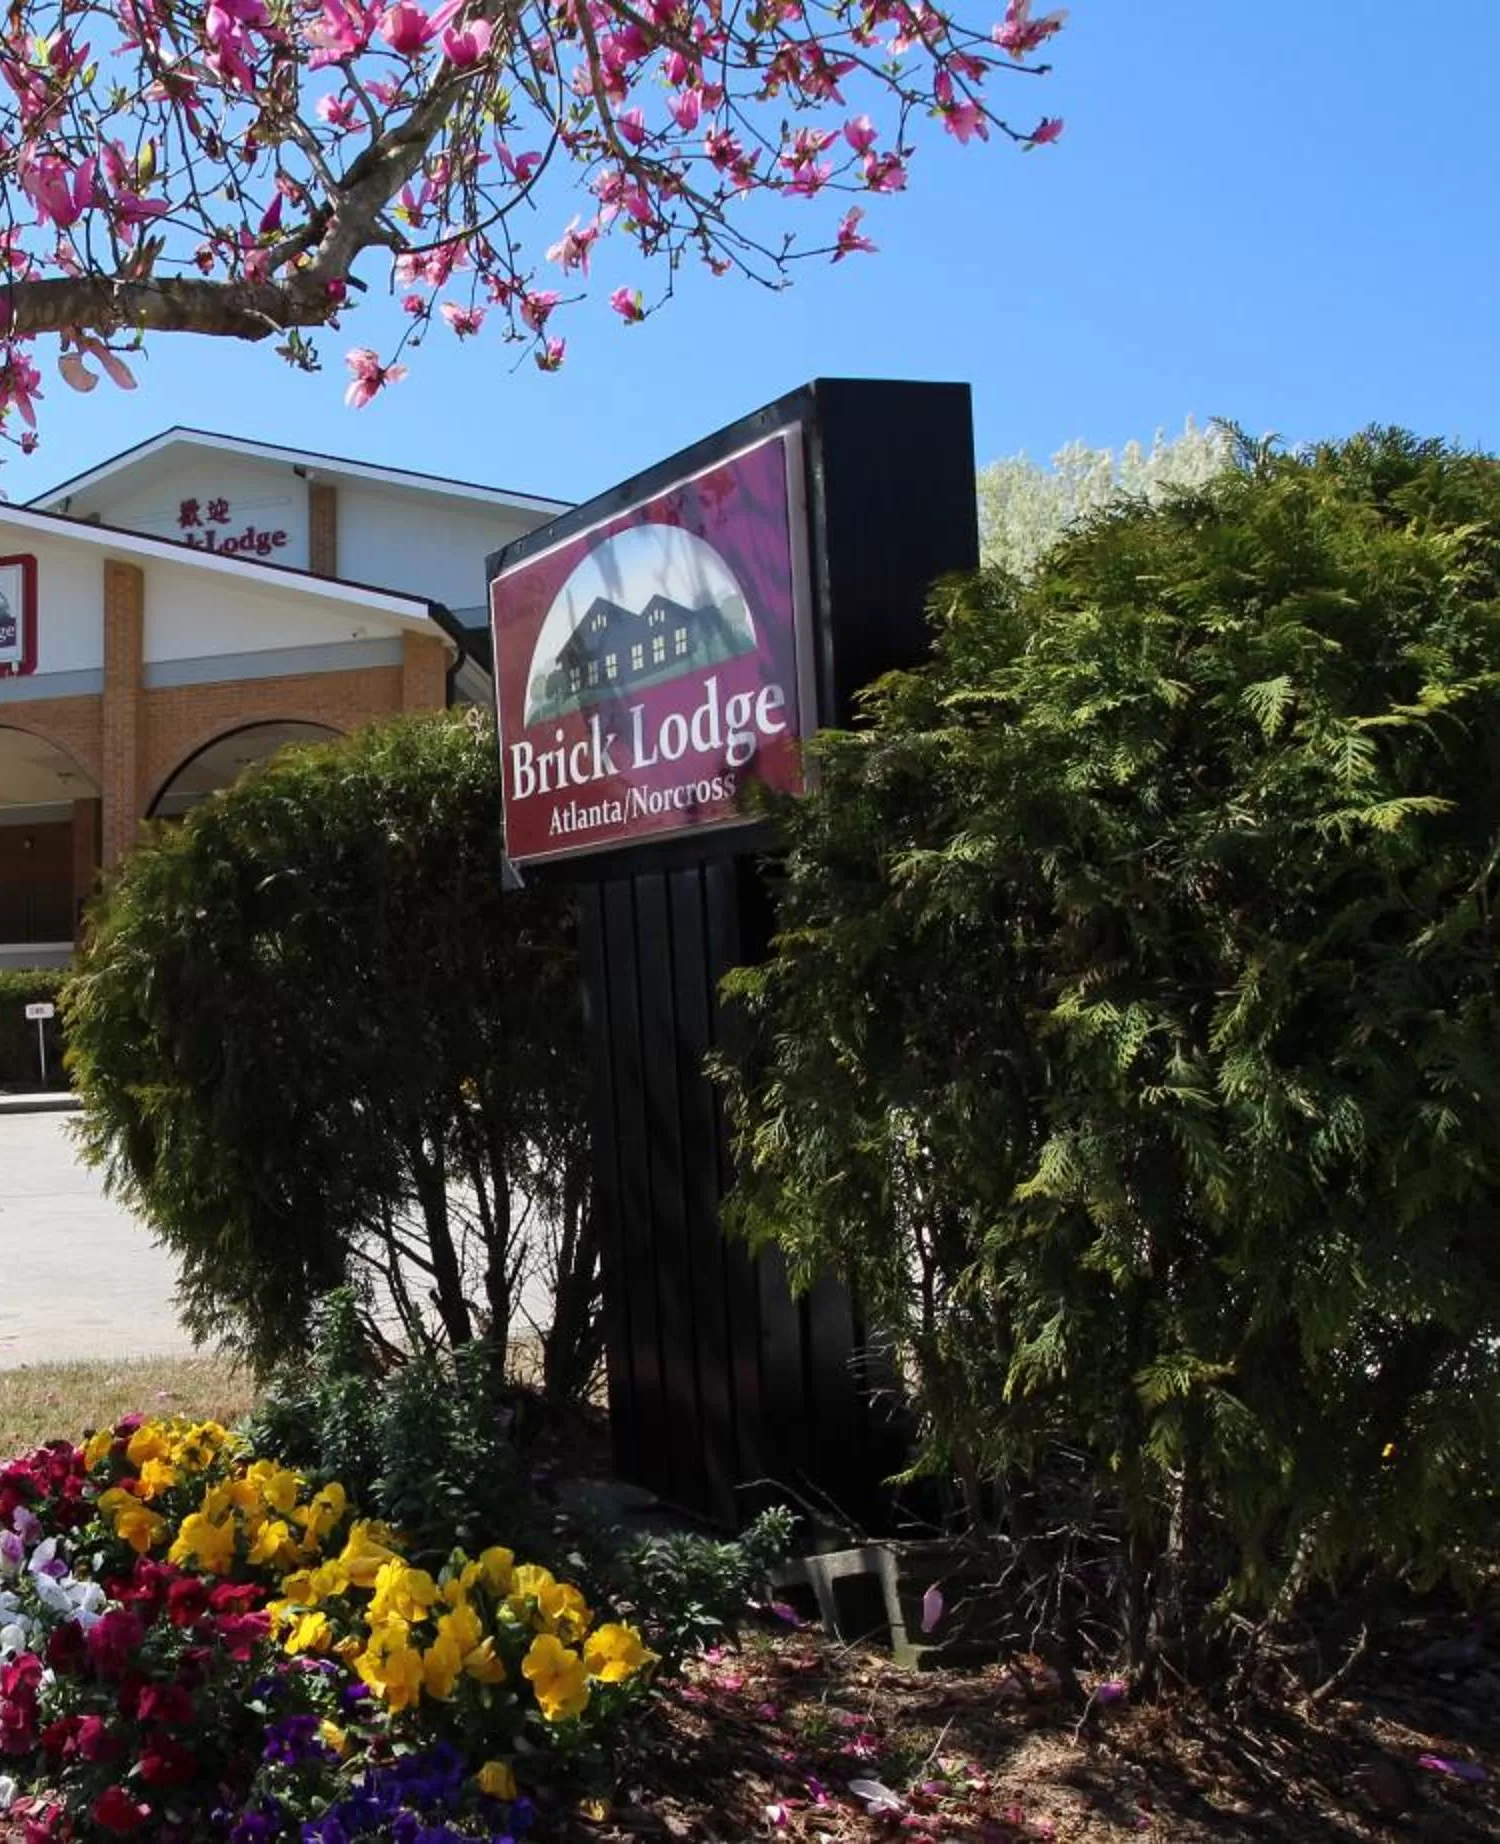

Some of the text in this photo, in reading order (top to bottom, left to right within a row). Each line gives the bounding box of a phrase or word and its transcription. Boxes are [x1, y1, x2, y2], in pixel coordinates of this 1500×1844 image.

[205, 526, 287, 556] Lodge
[510, 675, 787, 801] Brick Lodge
[549, 771, 737, 836] Atlanta/Norcross
